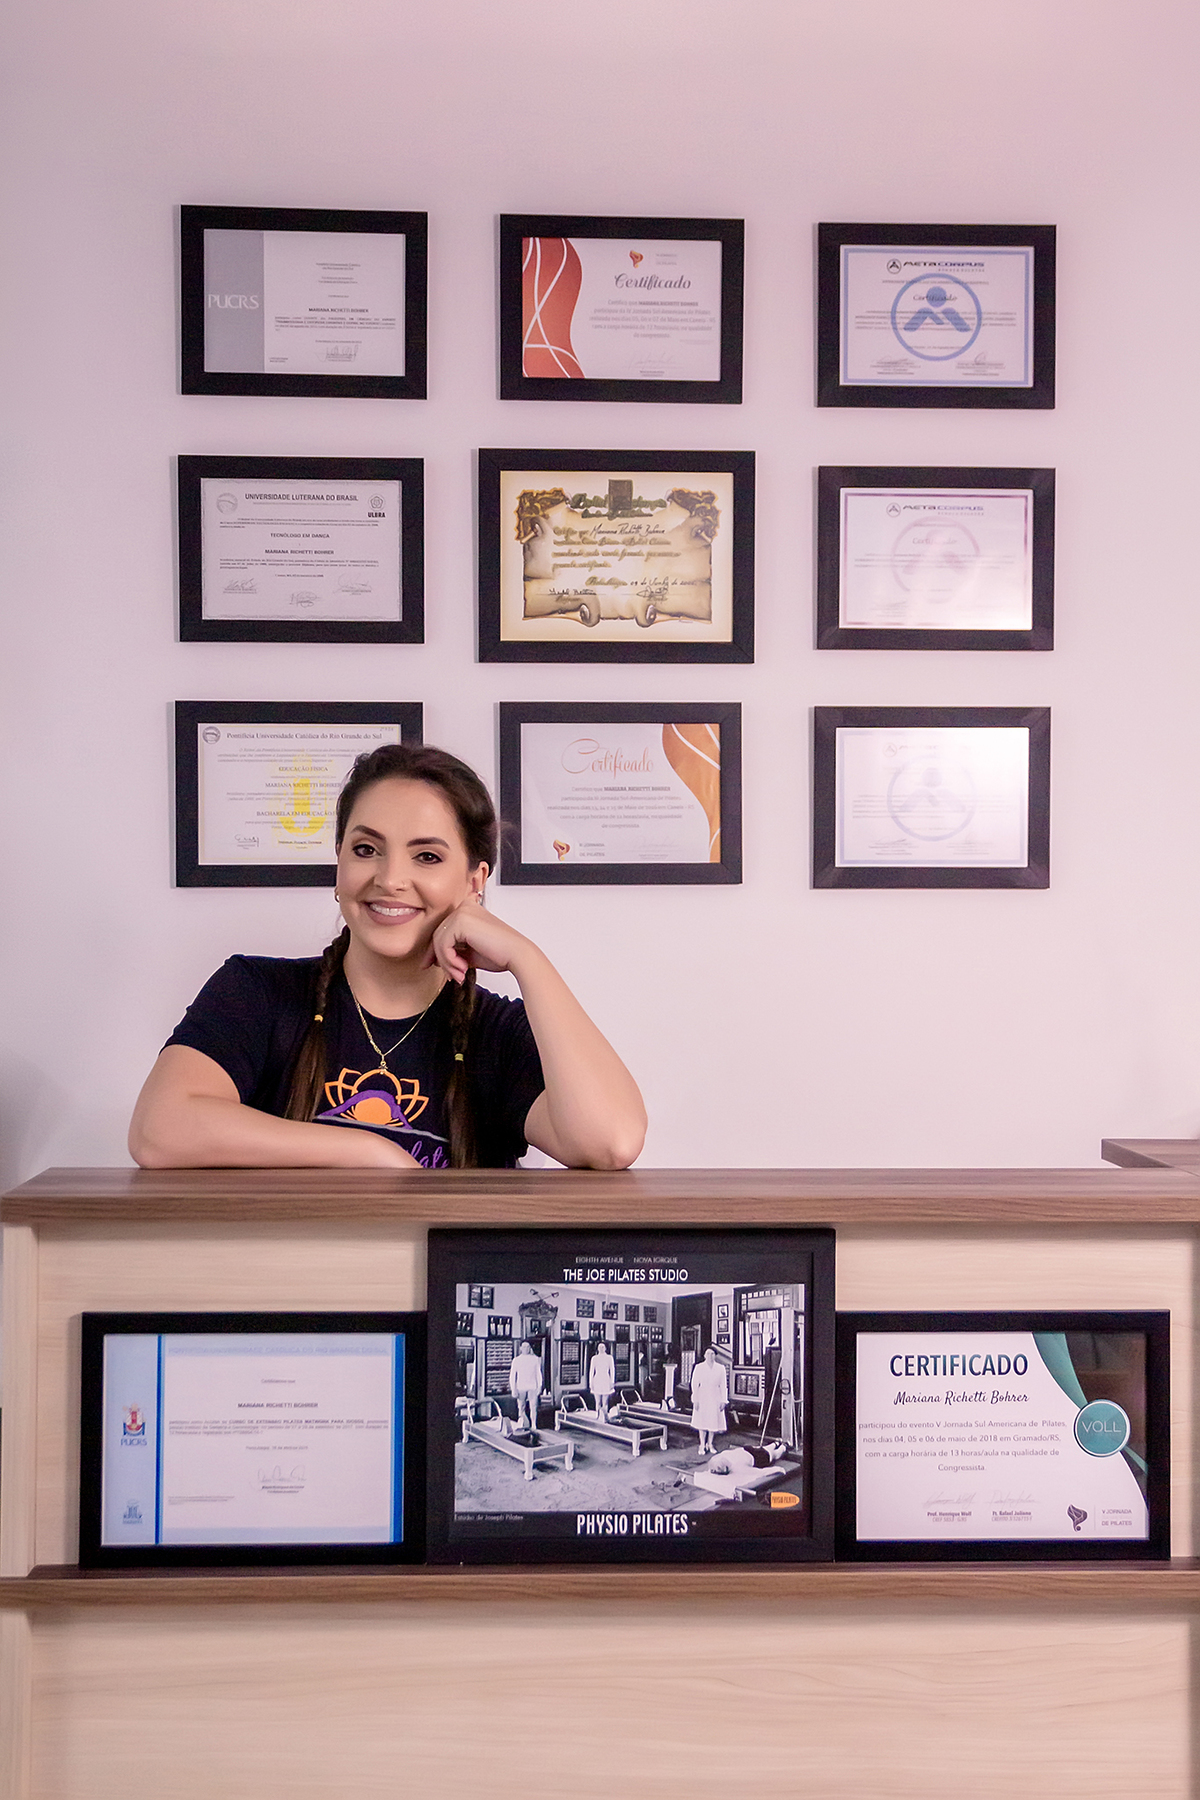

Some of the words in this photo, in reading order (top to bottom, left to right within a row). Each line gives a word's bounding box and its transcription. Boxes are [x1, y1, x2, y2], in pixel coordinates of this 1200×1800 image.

[614, 273, 691, 291] Certificado
[208, 294, 260, 310] PUCRS
[336, 494, 358, 502] BRASIL
[295, 732, 319, 740] Católica
[561, 738, 654, 779] Certificado
[575, 1256, 599, 1264] EIGHTH
[600, 1256, 624, 1264] AVENUE
[633, 1256, 651, 1264] NOVA
[563, 1268, 583, 1281] THE
[585, 1268, 605, 1281] JOE
[608, 1268, 646, 1281] PILATES
[649, 1268, 688, 1281] STUDIO
[889, 1353, 1029, 1377] CERTIFICADO
[893, 1391, 941, 1406] Mariana
[945, 1390, 987, 1406] Richetti
[990, 1390, 1030, 1405] Bohrer
[859, 1421, 896, 1430] participou
[987, 1420, 1026, 1428] Americana
[1028, 1420, 1038, 1428] de
[1082, 1420, 1122, 1433] VOLL
[121, 1438, 147, 1446] PUCRS
[894, 1436, 906, 1444] 04,
[907, 1435, 917, 1443] 05
[925, 1435, 935, 1443] 06
[936, 1435, 946, 1443] de
[1013, 1434, 1062, 1443] Gramado/RS,
[888, 1451, 909, 1459] carga
[960, 1449, 999, 1457] horas/aula
[1011, 1449, 1048, 1458] qualidade
[577, 1514, 628, 1535] PHYSIO
[632, 1514, 688, 1534] PILATES
